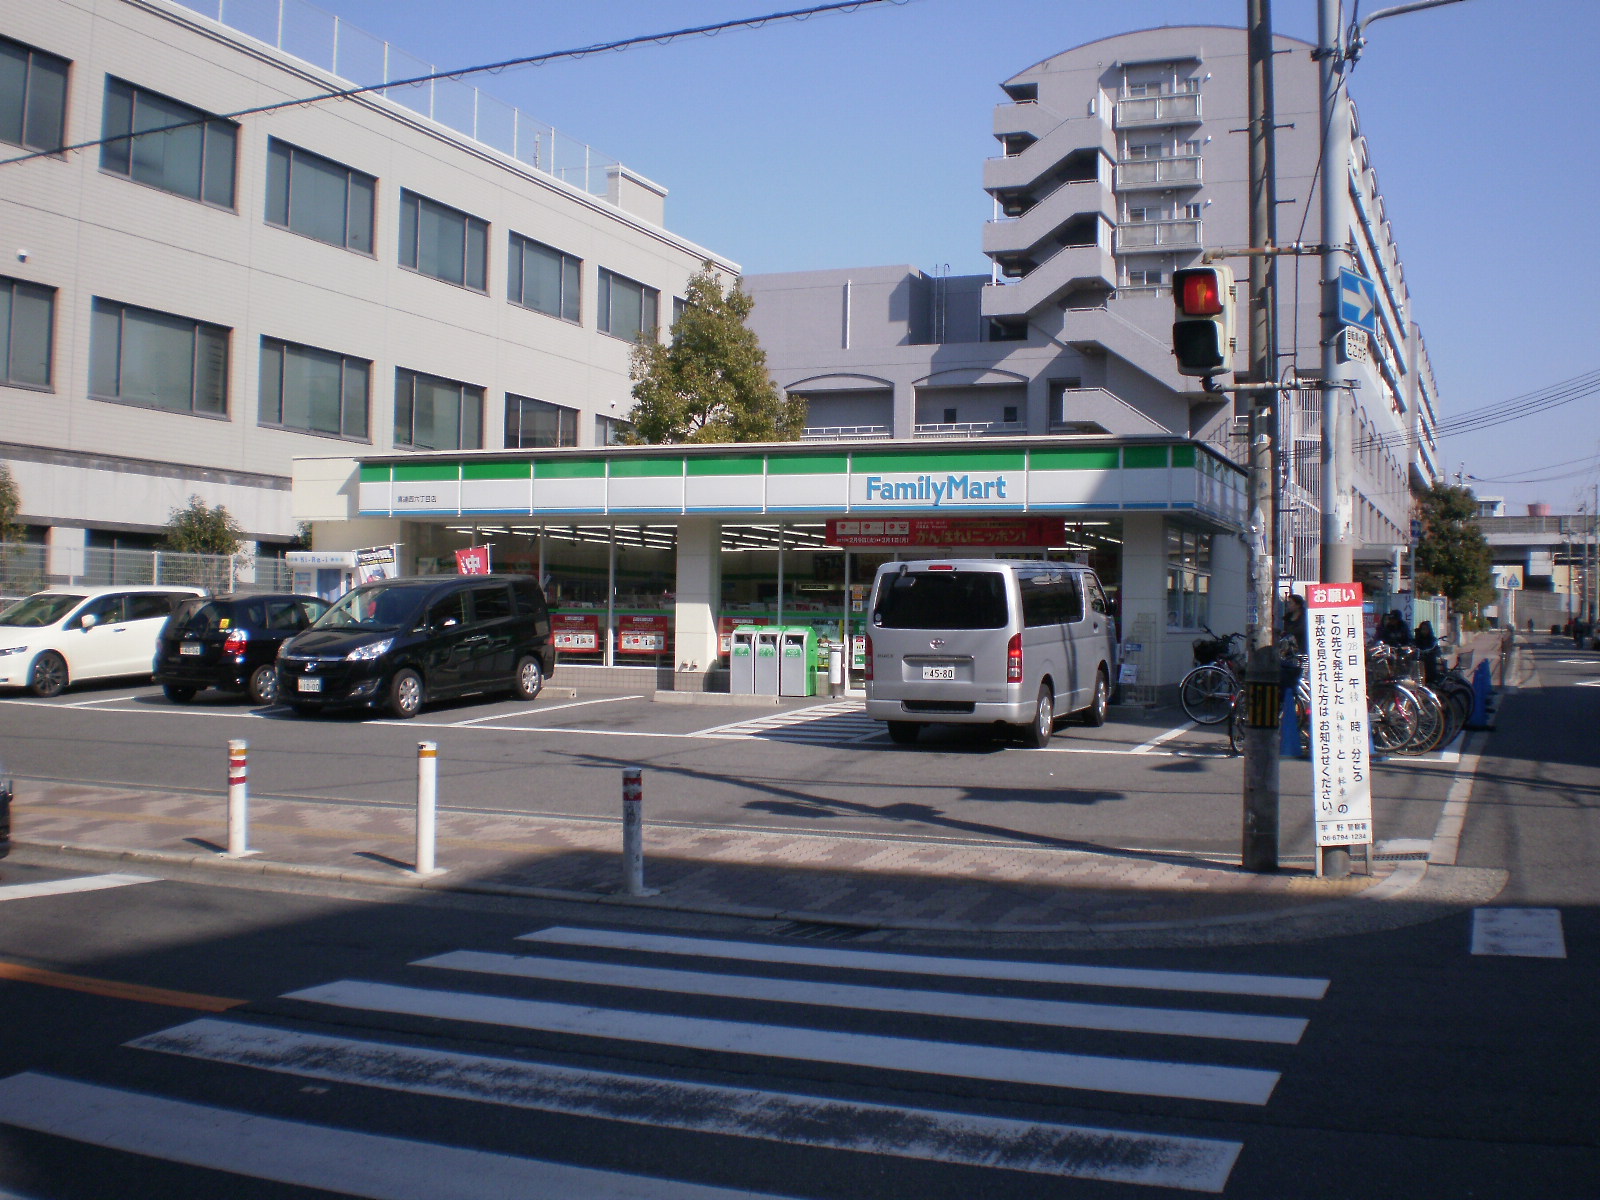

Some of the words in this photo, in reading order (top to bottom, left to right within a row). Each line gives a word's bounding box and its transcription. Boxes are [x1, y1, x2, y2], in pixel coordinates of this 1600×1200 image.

[1348, 343, 1366, 361] ここから
[866, 475, 1006, 506] FamilyMart
[1313, 588, 1356, 603] お願い
[929, 669, 953, 679] 45-80
